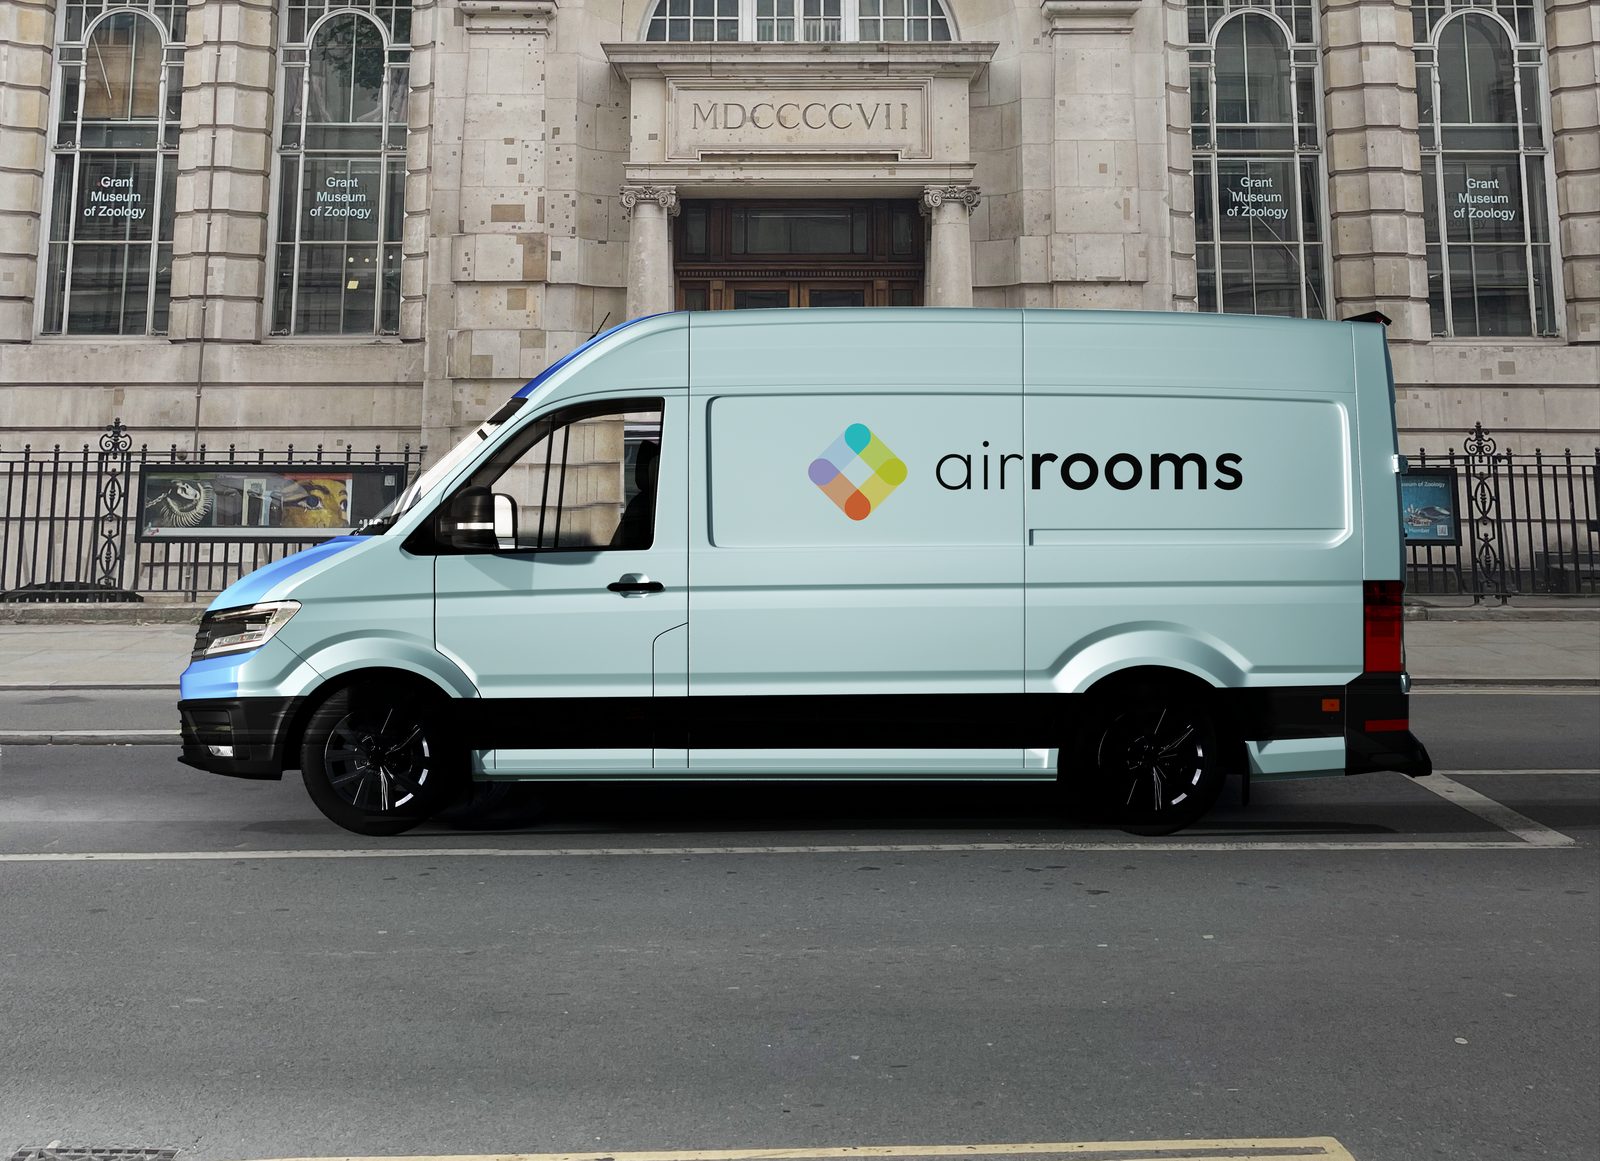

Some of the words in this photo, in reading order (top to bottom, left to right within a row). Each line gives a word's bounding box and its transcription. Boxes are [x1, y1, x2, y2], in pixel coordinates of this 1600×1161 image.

[692, 103, 908, 130] MDCCCCVII
[100, 176, 133, 188] Grant
[326, 177, 358, 188] Grant
[1240, 177, 1273, 188] Grant
[1466, 178, 1499, 189] Grant
[91, 191, 141, 202] Museum
[316, 191, 366, 202] Museum
[1232, 192, 1282, 203] Museum
[1458, 193, 1508, 204] Museum
[84, 206, 98, 217] of
[99, 206, 146, 219] Zoology
[310, 206, 322, 217] of
[324, 206, 371, 219] Zoology
[1227, 206, 1241, 217] of
[1242, 206, 1288, 219] Zoology
[1453, 208, 1466, 218] of
[1468, 208, 1515, 221] Zoology
[936, 440, 1244, 491] airrooms
